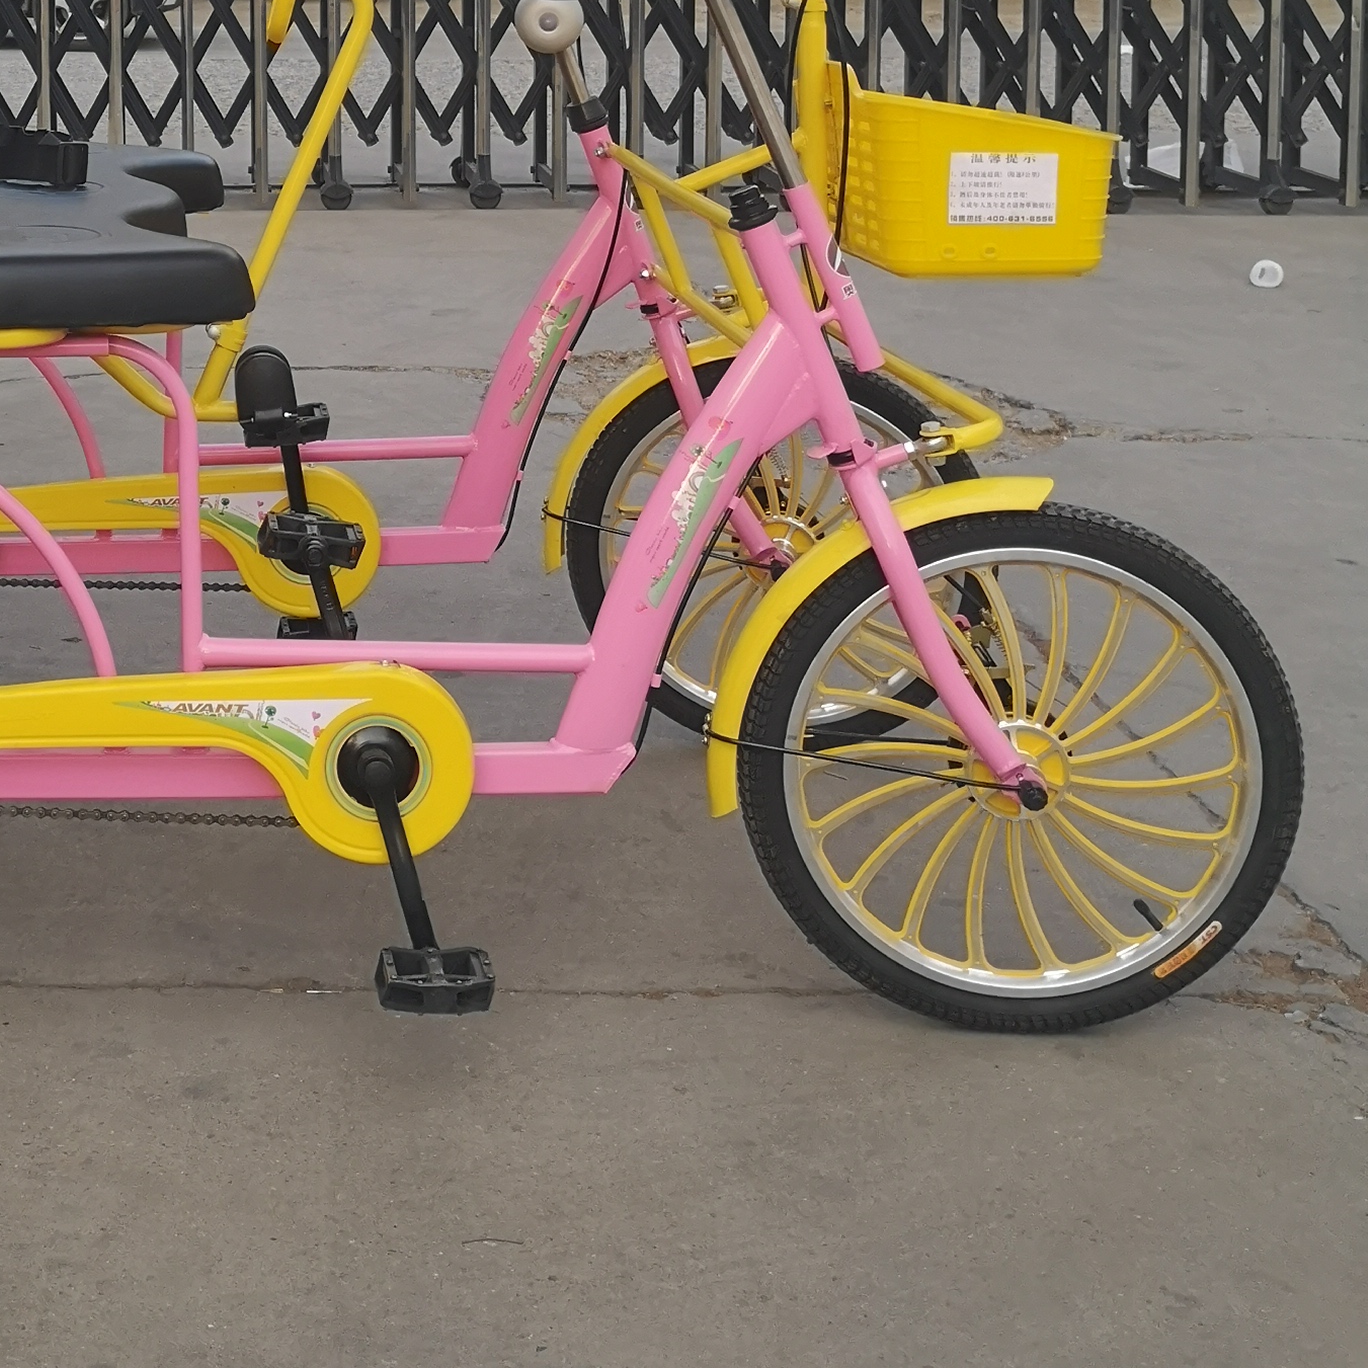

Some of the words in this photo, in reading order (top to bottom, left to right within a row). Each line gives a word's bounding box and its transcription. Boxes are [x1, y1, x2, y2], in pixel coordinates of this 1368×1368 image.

[970, 153, 1036, 164] 温馨提示
[150, 497, 209, 506] AVAT
[172, 702, 249, 713] AVANT
